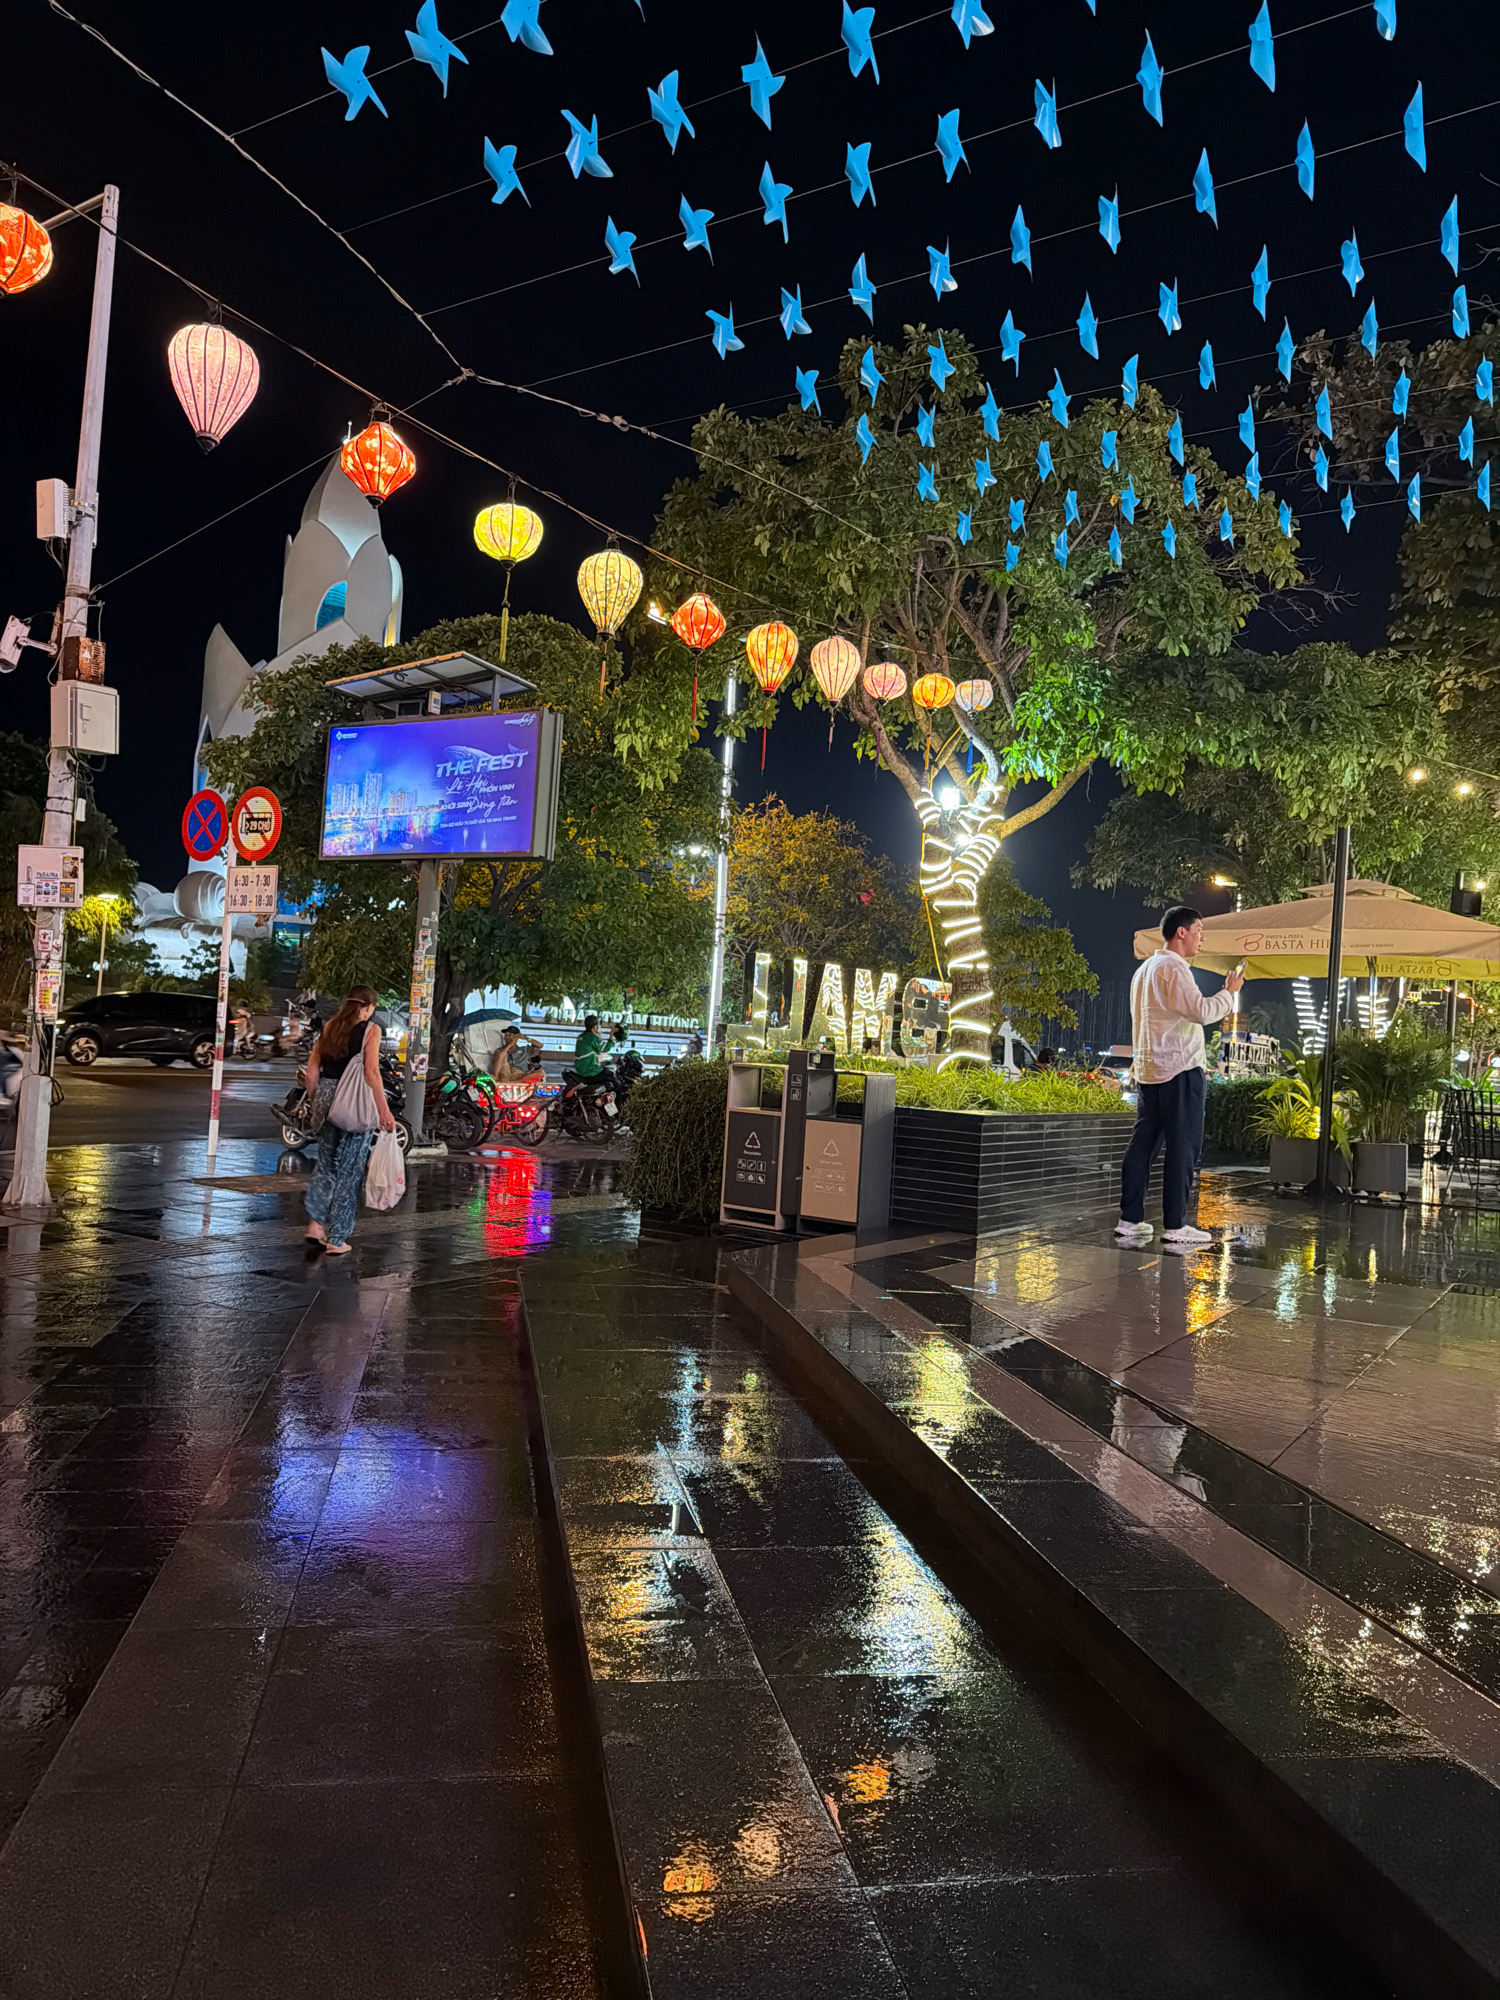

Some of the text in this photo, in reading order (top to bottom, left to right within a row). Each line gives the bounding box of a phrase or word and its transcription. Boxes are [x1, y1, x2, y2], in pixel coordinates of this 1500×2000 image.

[436, 751, 528, 778] THE FEST
[499, 783, 515, 791] VINH
[234, 875, 249, 886] 6:30
[256, 875, 271, 886] 7:30
[230, 895, 247, 907] 16:30
[255, 895, 273, 907] 18:30
[1265, 940, 1304, 950] BASTA
